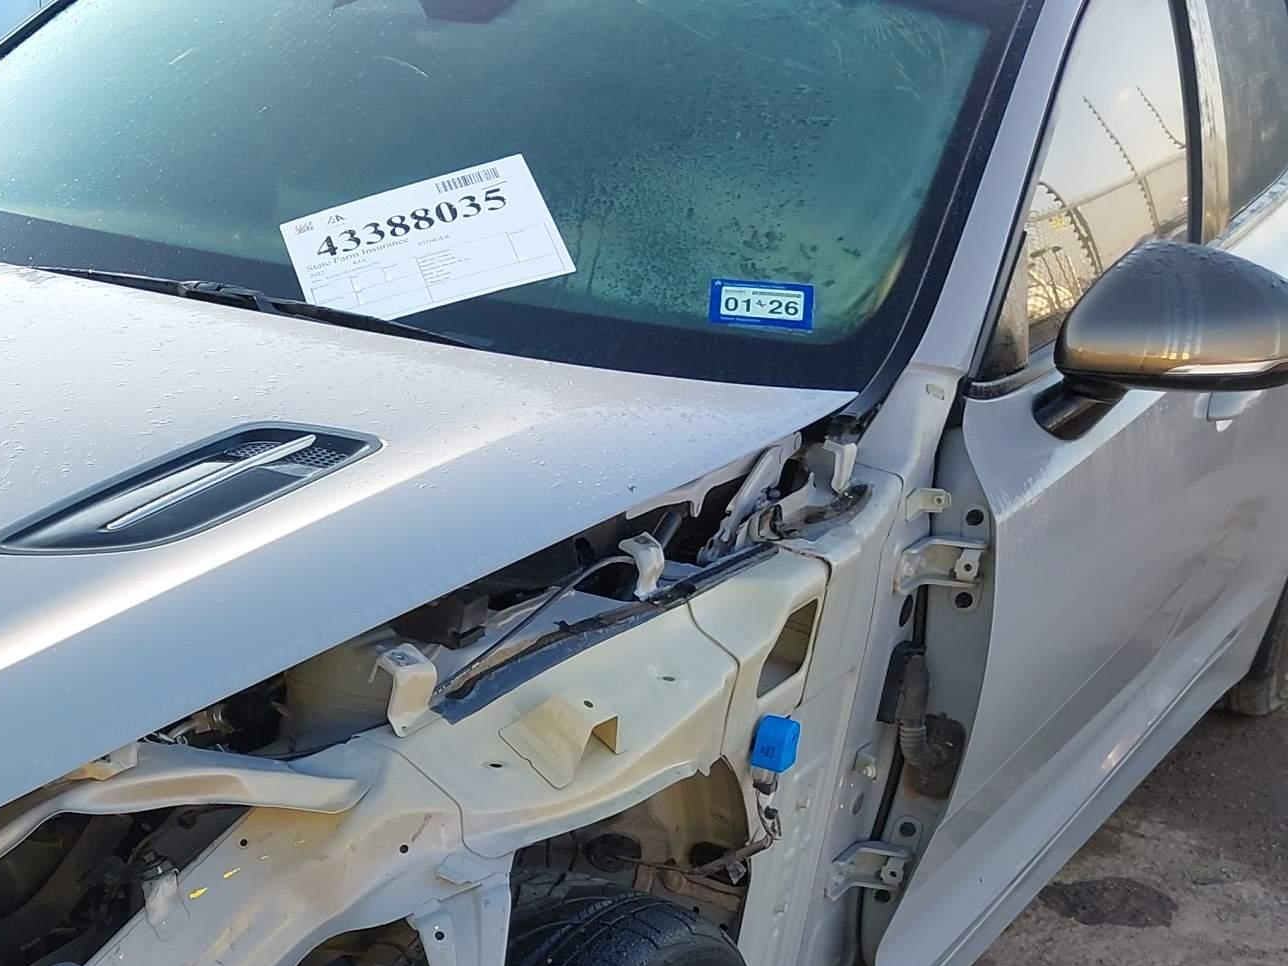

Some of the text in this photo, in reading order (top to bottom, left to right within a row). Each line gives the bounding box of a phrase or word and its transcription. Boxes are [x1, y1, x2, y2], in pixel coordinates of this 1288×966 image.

[317, 188, 507, 256] 43388035
[306, 236, 409, 272] State Farm Insurance
[724, 296, 799, 316] 01 26
